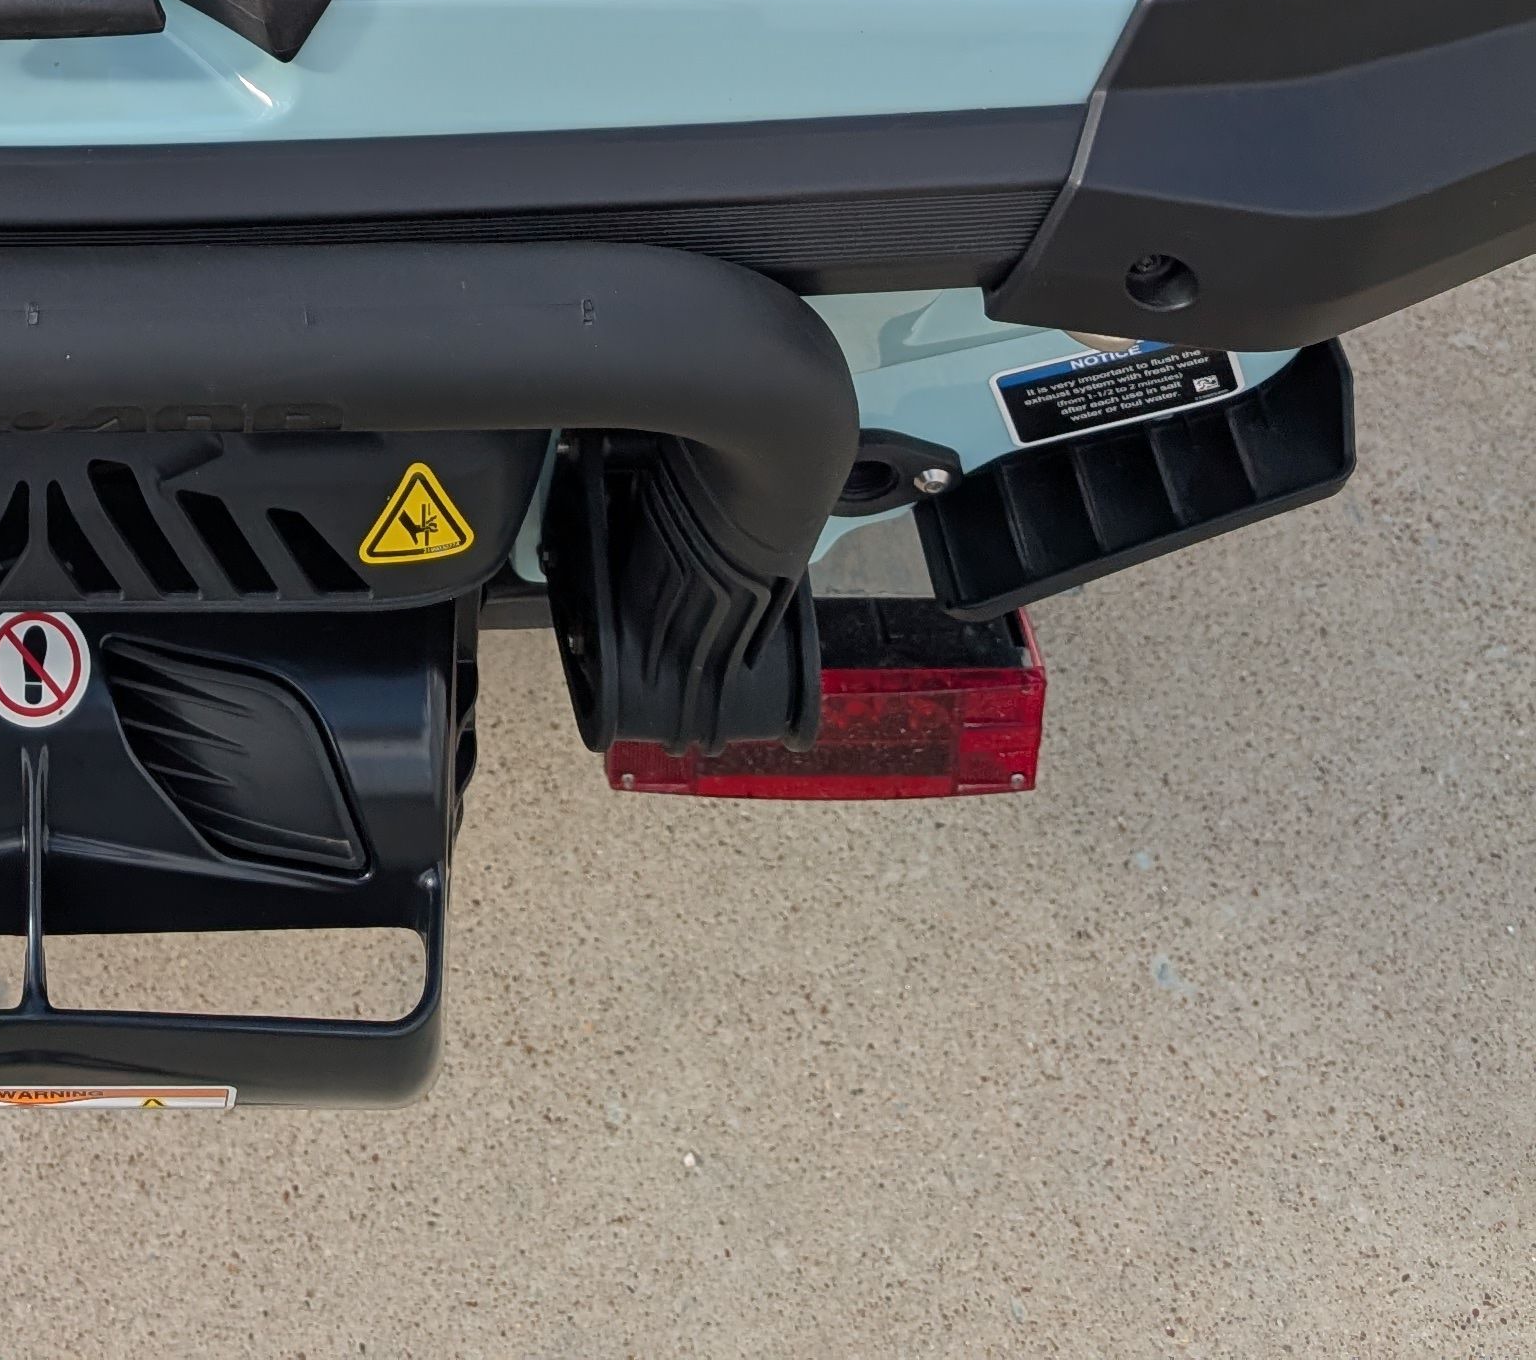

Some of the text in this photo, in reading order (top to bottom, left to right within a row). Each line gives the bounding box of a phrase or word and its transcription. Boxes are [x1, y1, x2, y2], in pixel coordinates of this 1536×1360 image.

[1026, 349, 1201, 397] It is very important to flush the
[1070, 344, 1143, 371] NOTICE
[1024, 356, 1209, 407] exhaust system with fresh water
[1057, 371, 1184, 409] (from 1-1/2 to 2 minutes)
[1060, 380, 1183, 416] after each use in salt
[1070, 408, 1103, 422] water
[1105, 405, 1117, 414] or
[1119, 398, 1143, 411] foul
[1145, 391, 1182, 405] water.
